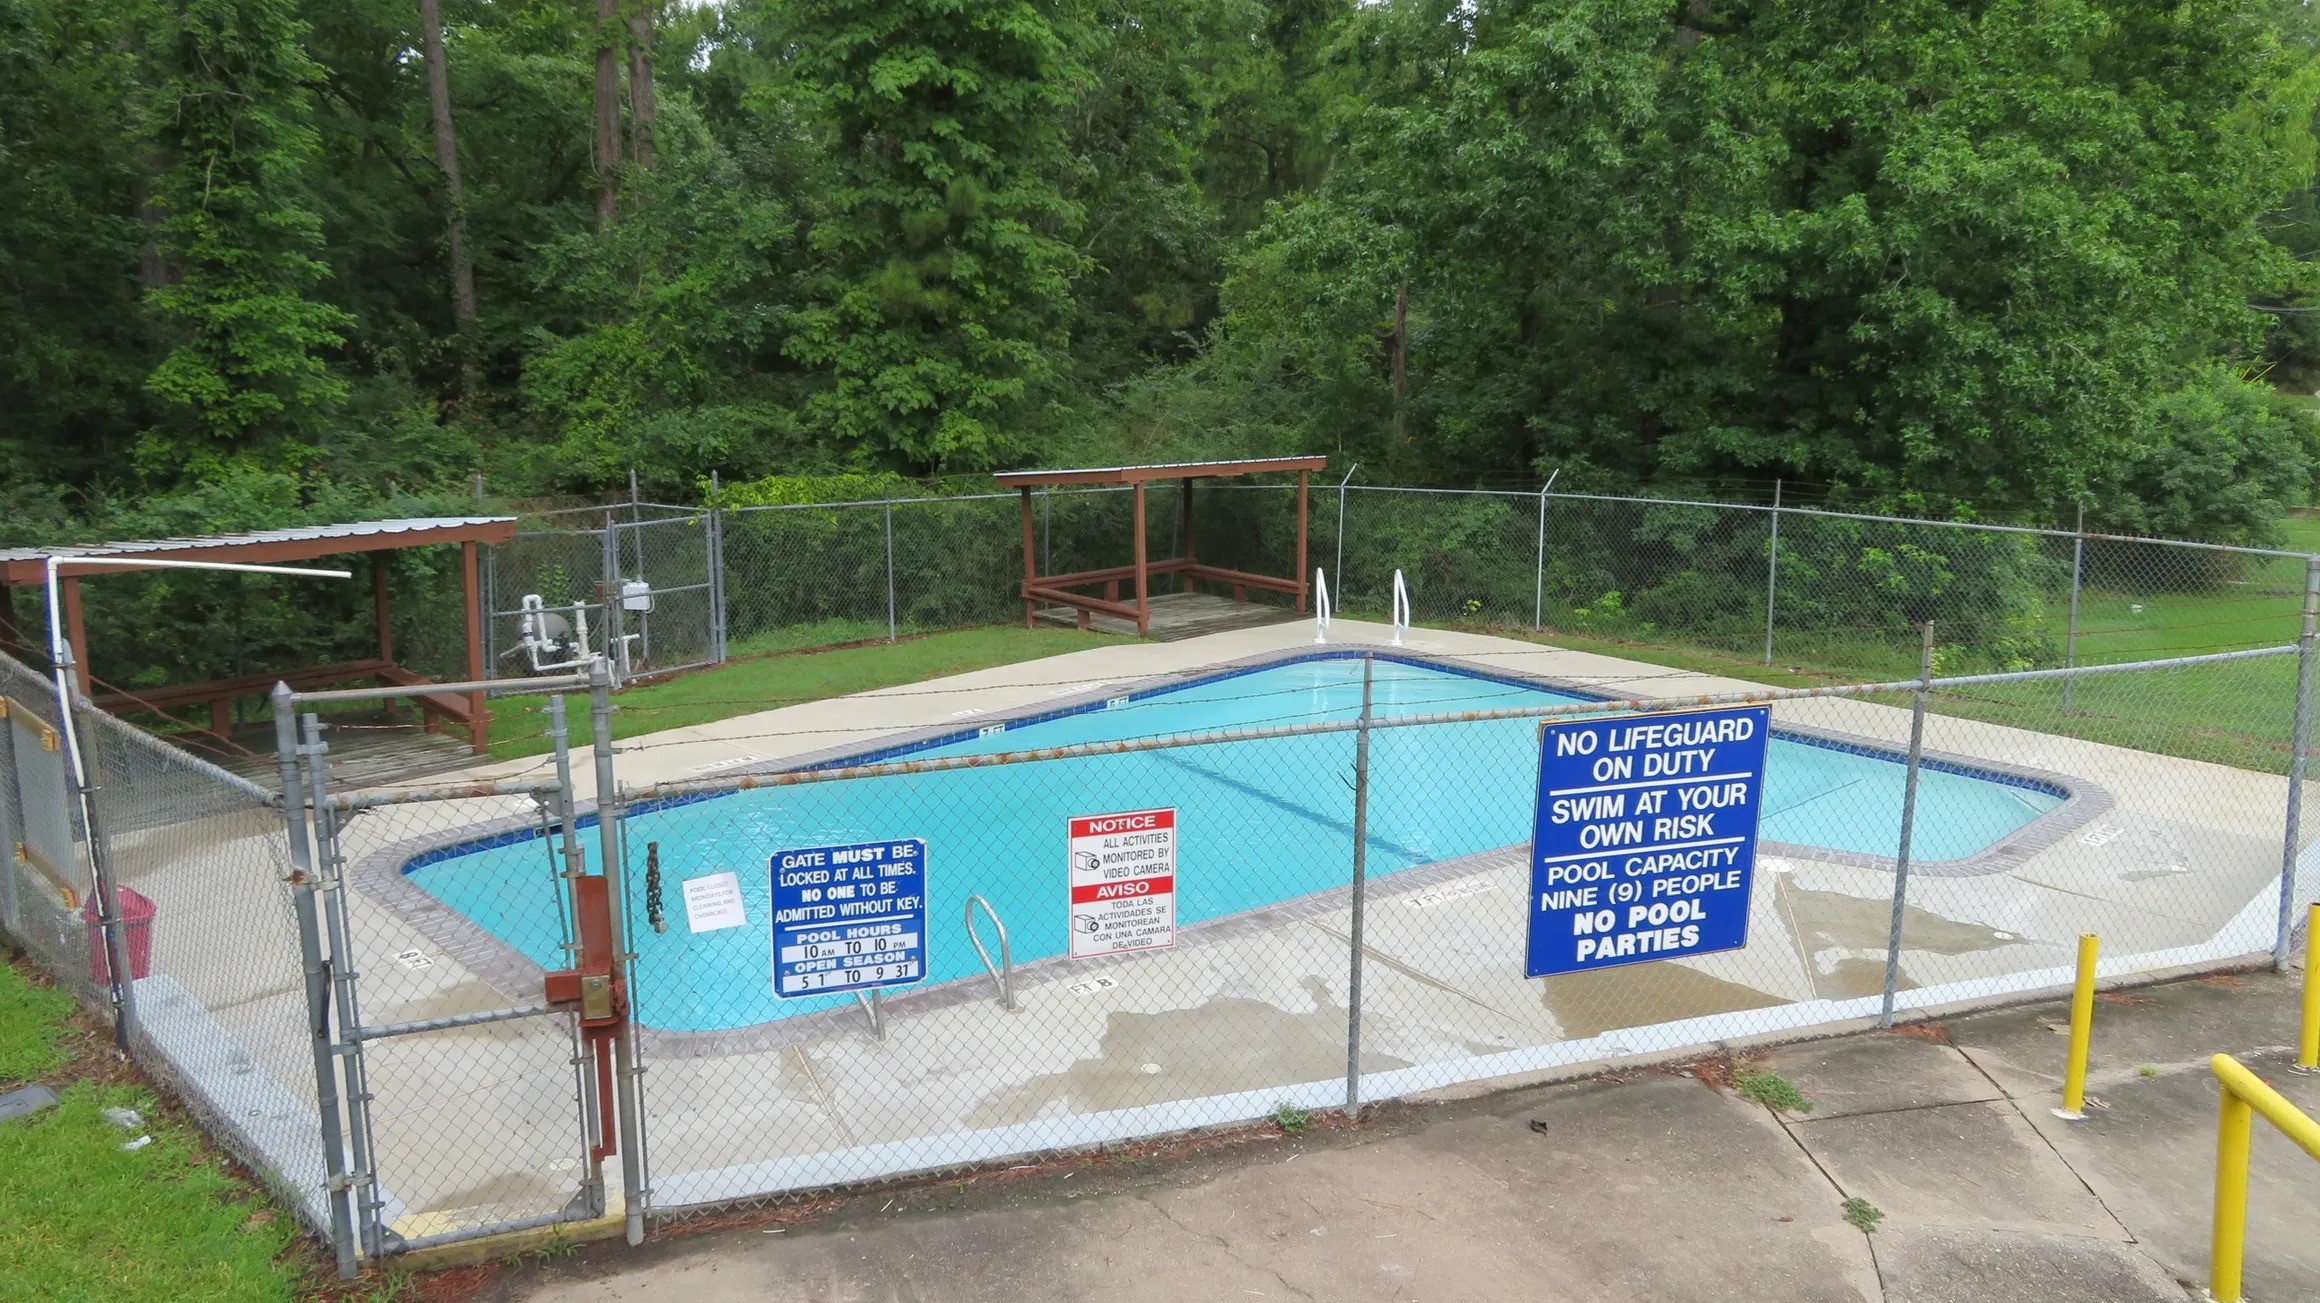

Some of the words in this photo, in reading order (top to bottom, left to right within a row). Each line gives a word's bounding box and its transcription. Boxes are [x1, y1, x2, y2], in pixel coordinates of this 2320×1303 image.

[1558, 730, 1597, 756] NO
[1609, 717, 1754, 752] LIFEGUARD
[1593, 756, 1633, 781] ON
[1644, 749, 1715, 777] DUTY
[1552, 794, 1624, 824] SWIM
[1635, 790, 1668, 815] AT
[1678, 783, 1747, 810] YOUR
[1090, 815, 1155, 833] NOTICE
[1580, 821, 1643, 849] OWN
[1654, 813, 1715, 841] RISK
[1103, 838, 1119, 849] ALL
[1123, 832, 1168, 846] ACTIVITIES
[782, 853, 825, 868] GATE
[832, 848, 885, 864] MUST
[892, 845, 913, 858] BE
[1103, 850, 1153, 864] MONITORED
[1158, 848, 1170, 858] BY
[1548, 862, 1615, 885] POOL
[1625, 847, 1739, 877] CAPACITY
[780, 872, 829, 887] LOCKED
[834, 870, 848, 882] AT
[852, 867, 873, 880] ALL
[878, 862, 915, 877] TIMES.
[1103, 867, 1130, 879] VIDEO
[1134, 863, 1170, 876] CAMERA
[802, 889, 821, 902] NO
[827, 886, 855, 899] ONE
[860, 884, 876, 896] TO
[880, 882, 896, 894] BE
[1097, 881, 1149, 898] AVISO
[1541, 888, 1598, 911] NINE
[1608, 881, 1642, 905] (9)
[1652, 870, 1741, 897] PEOPLE
[775, 905, 835, 923] ADMITTED
[840, 900, 892, 916] WITHOUT
[897, 897, 922, 910] KEY.
[1098, 908, 1152, 920] ACTIVIDADES
[1156, 906, 1167, 914] SE
[1112, 900, 1134, 909] TODA
[1137, 898, 1153, 906] LAS
[1105, 917, 1159, 930] MONITOREAN
[1574, 910, 1616, 936] NO
[1629, 899, 1706, 928] POOL
[797, 930, 840, 944] POOL
[847, 924, 901, 938] HOURS
[1093, 932, 1112, 942] CON
[1116, 930, 1132, 939] UNA
[1136, 926, 1171, 936] CAMARA
[1127, 937, 1152, 947] VIDEO
[1576, 925, 1699, 962] PARTIES
[804, 946, 818, 958] 10
[821, 949, 835, 957] AM
[845, 942, 861, 954] TO
[875, 939, 887, 951] 10
[893, 941, 906, 949] PM
[795, 959, 836, 974] OPEN
[844, 951, 905, 967] SEASON
[802, 976, 809, 989] 5
[845, 970, 860, 982] TO
[876, 967, 883, 979] 9
